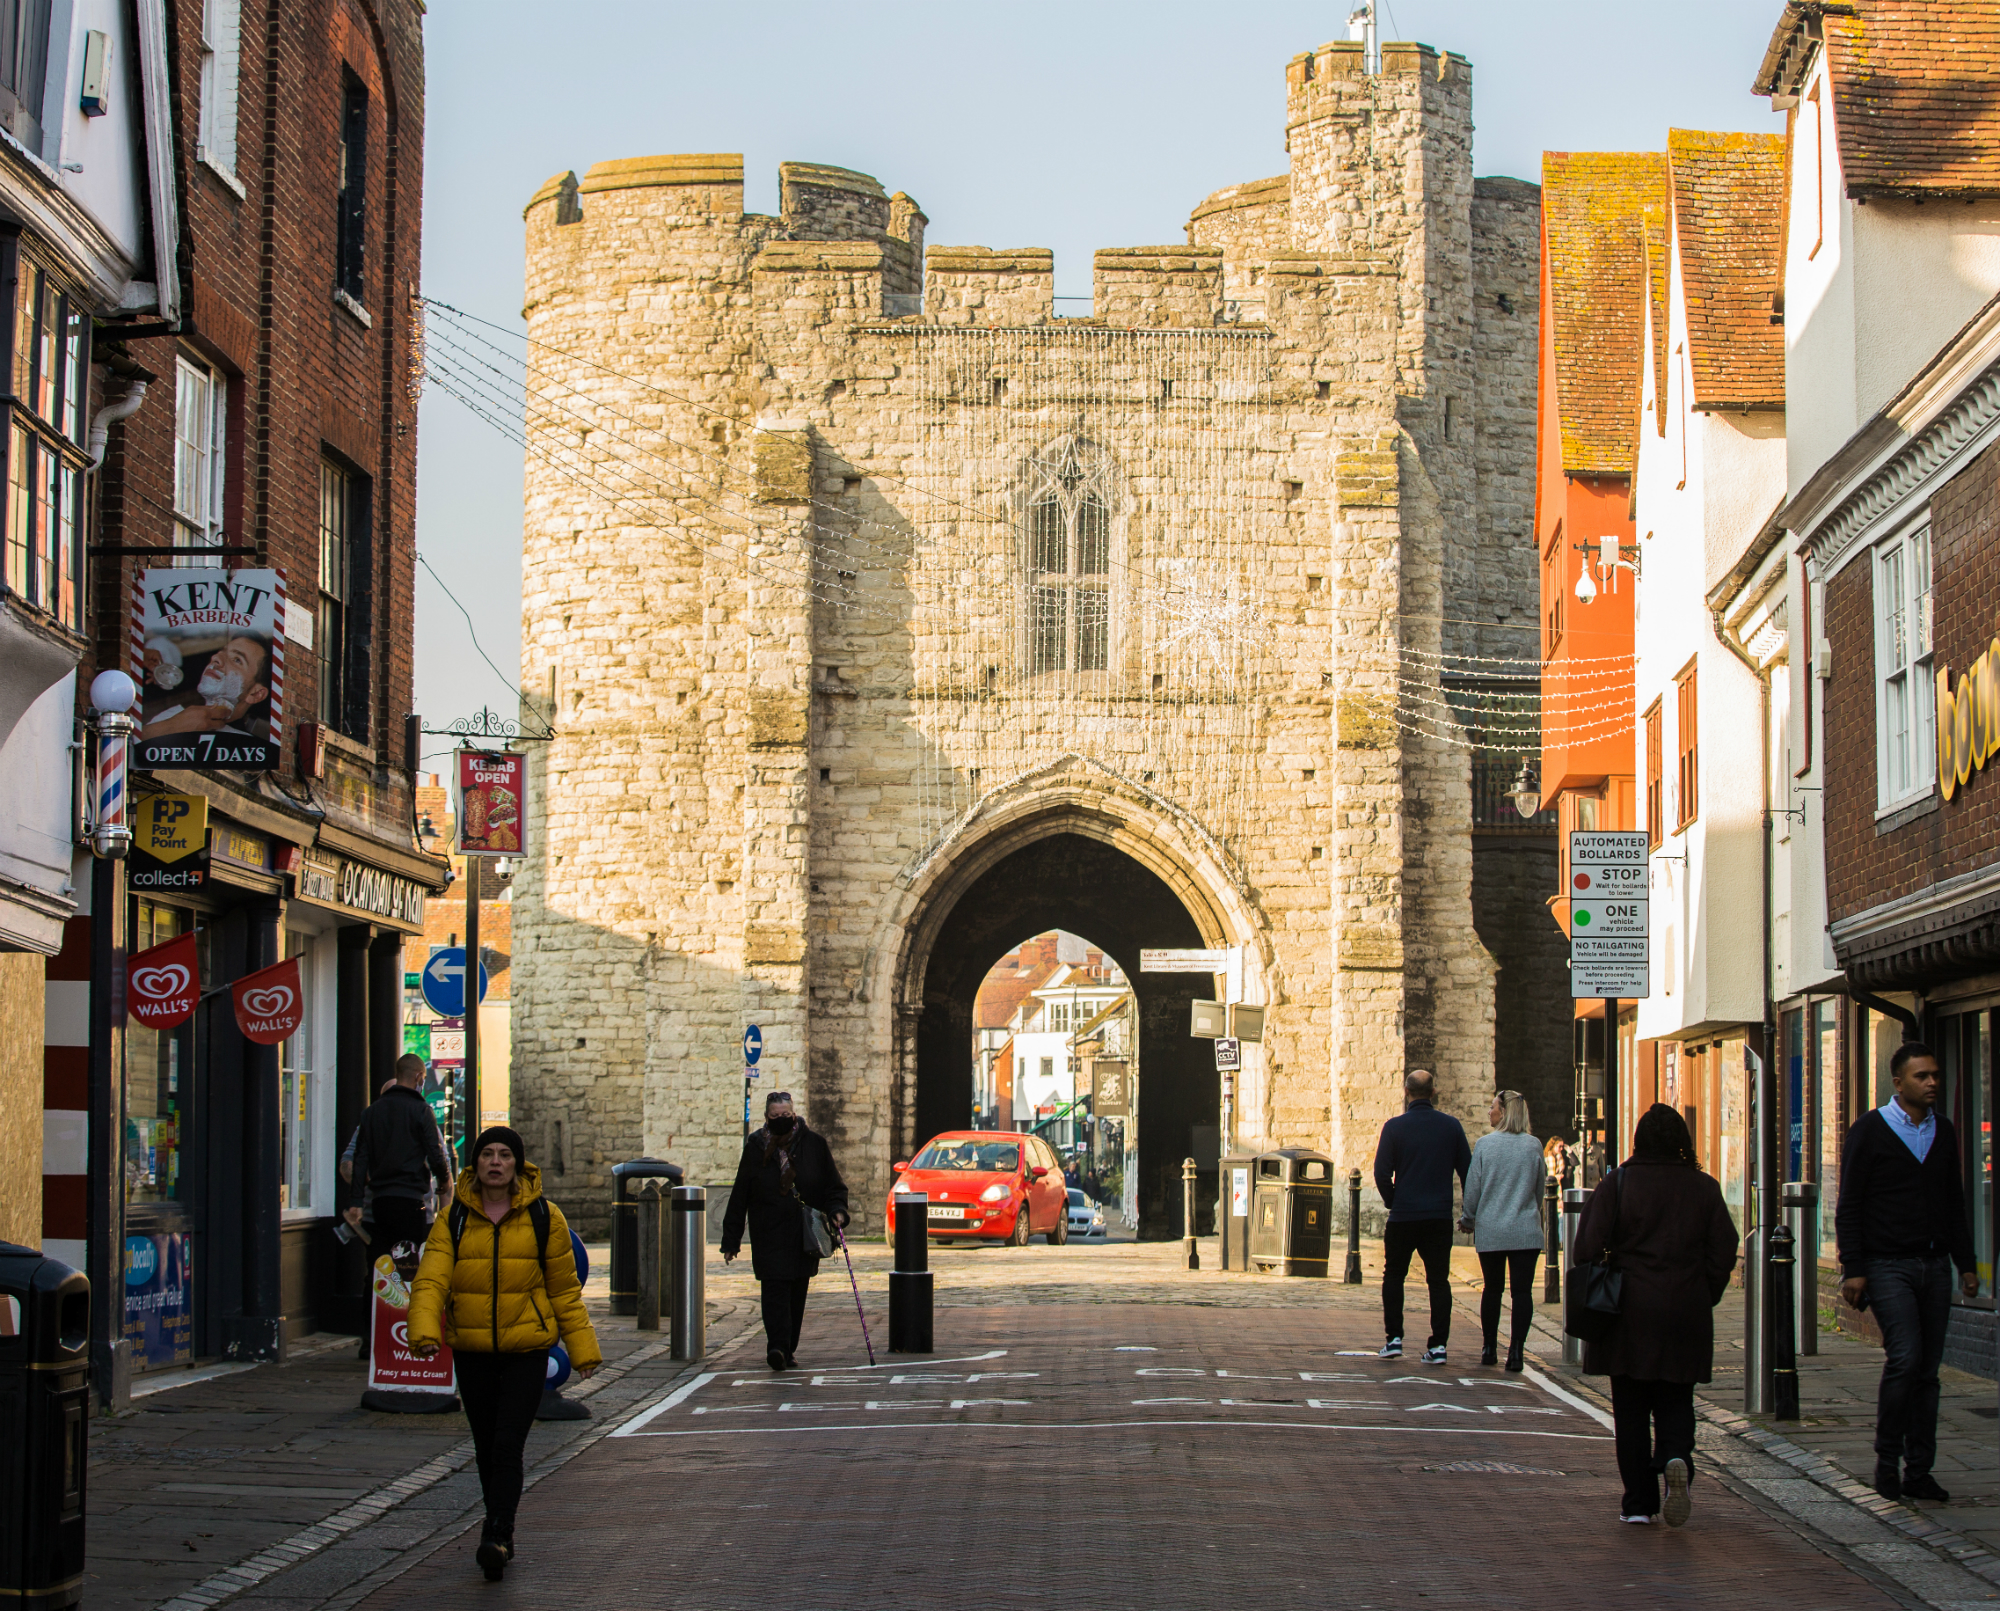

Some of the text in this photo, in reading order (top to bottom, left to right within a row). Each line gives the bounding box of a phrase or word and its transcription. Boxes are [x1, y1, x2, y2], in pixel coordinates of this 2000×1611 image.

[149, 581, 271, 619] KENT
[166, 610, 254, 628] BARBERS
[145, 734, 266, 762] OPEN 7 DAYS
[469, 758, 516, 773] KEBAB
[474, 772, 510, 784] OPEN
[152, 824, 176, 838] Pay
[151, 836, 187, 849] Point
[1573, 837, 1646, 847] AUTOMATED
[1579, 849, 1641, 859] BOLLARDS
[1602, 868, 1641, 880] STOP
[1605, 905, 1638, 917] ONE
[1616, 925, 1644, 933] proceed
[1591, 942, 1645, 950] TAILGATING
[137, 999, 190, 1017] WALL'S
[246, 1016, 293, 1033] WALL'S
[1218, 1051, 1235, 1060] CCTV
[928, 1208, 961, 1218] E64 VXJ
[377, 1368, 398, 1379] Fancy
[410, 1370, 422, 1378] Ice
[422, 1370, 448, 1379] Cream?
[731, 1368, 1528, 1390] KEEP CLEAR
[690, 1397, 1566, 1416] KEEP CLEAR
